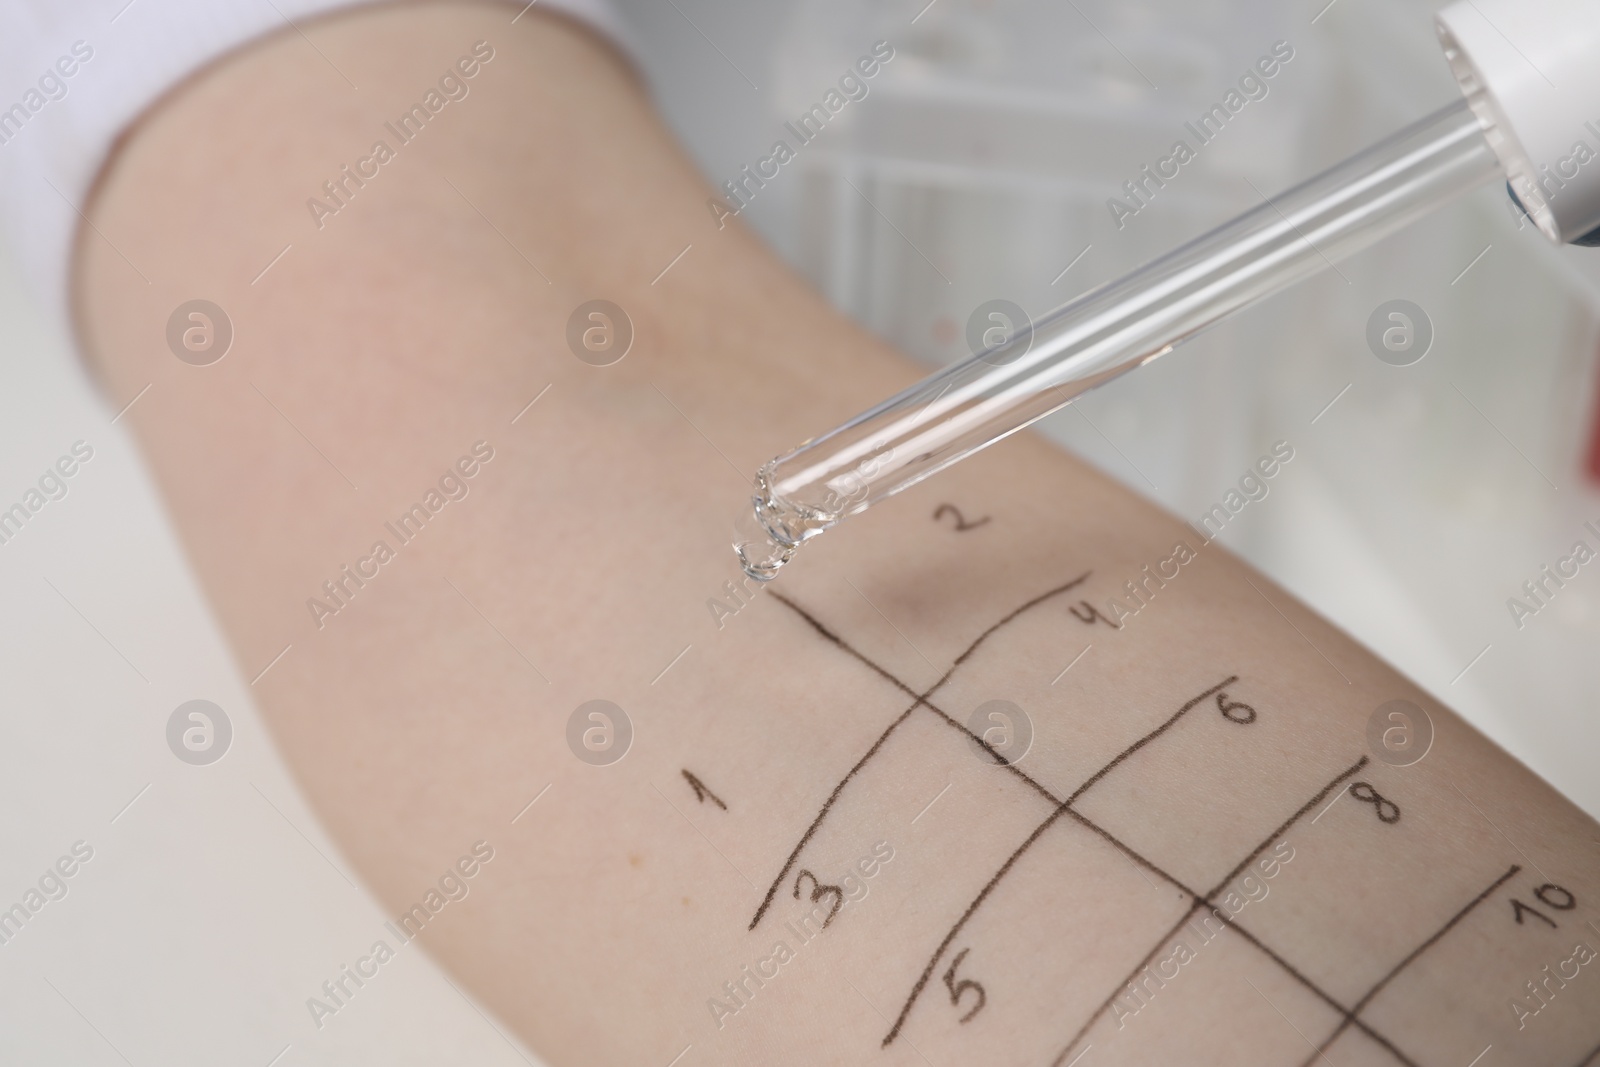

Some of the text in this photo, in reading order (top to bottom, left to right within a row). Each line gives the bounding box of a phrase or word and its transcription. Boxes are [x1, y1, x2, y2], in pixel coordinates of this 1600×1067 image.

[933, 502, 992, 534] 2
[1216, 693, 1257, 724] 6
[681, 768, 728, 812] 1
[1349, 781, 1400, 824] 8
[793, 869, 842, 932] 3
[1509, 883, 1577, 929] 10
[943, 947, 986, 1024] 5
